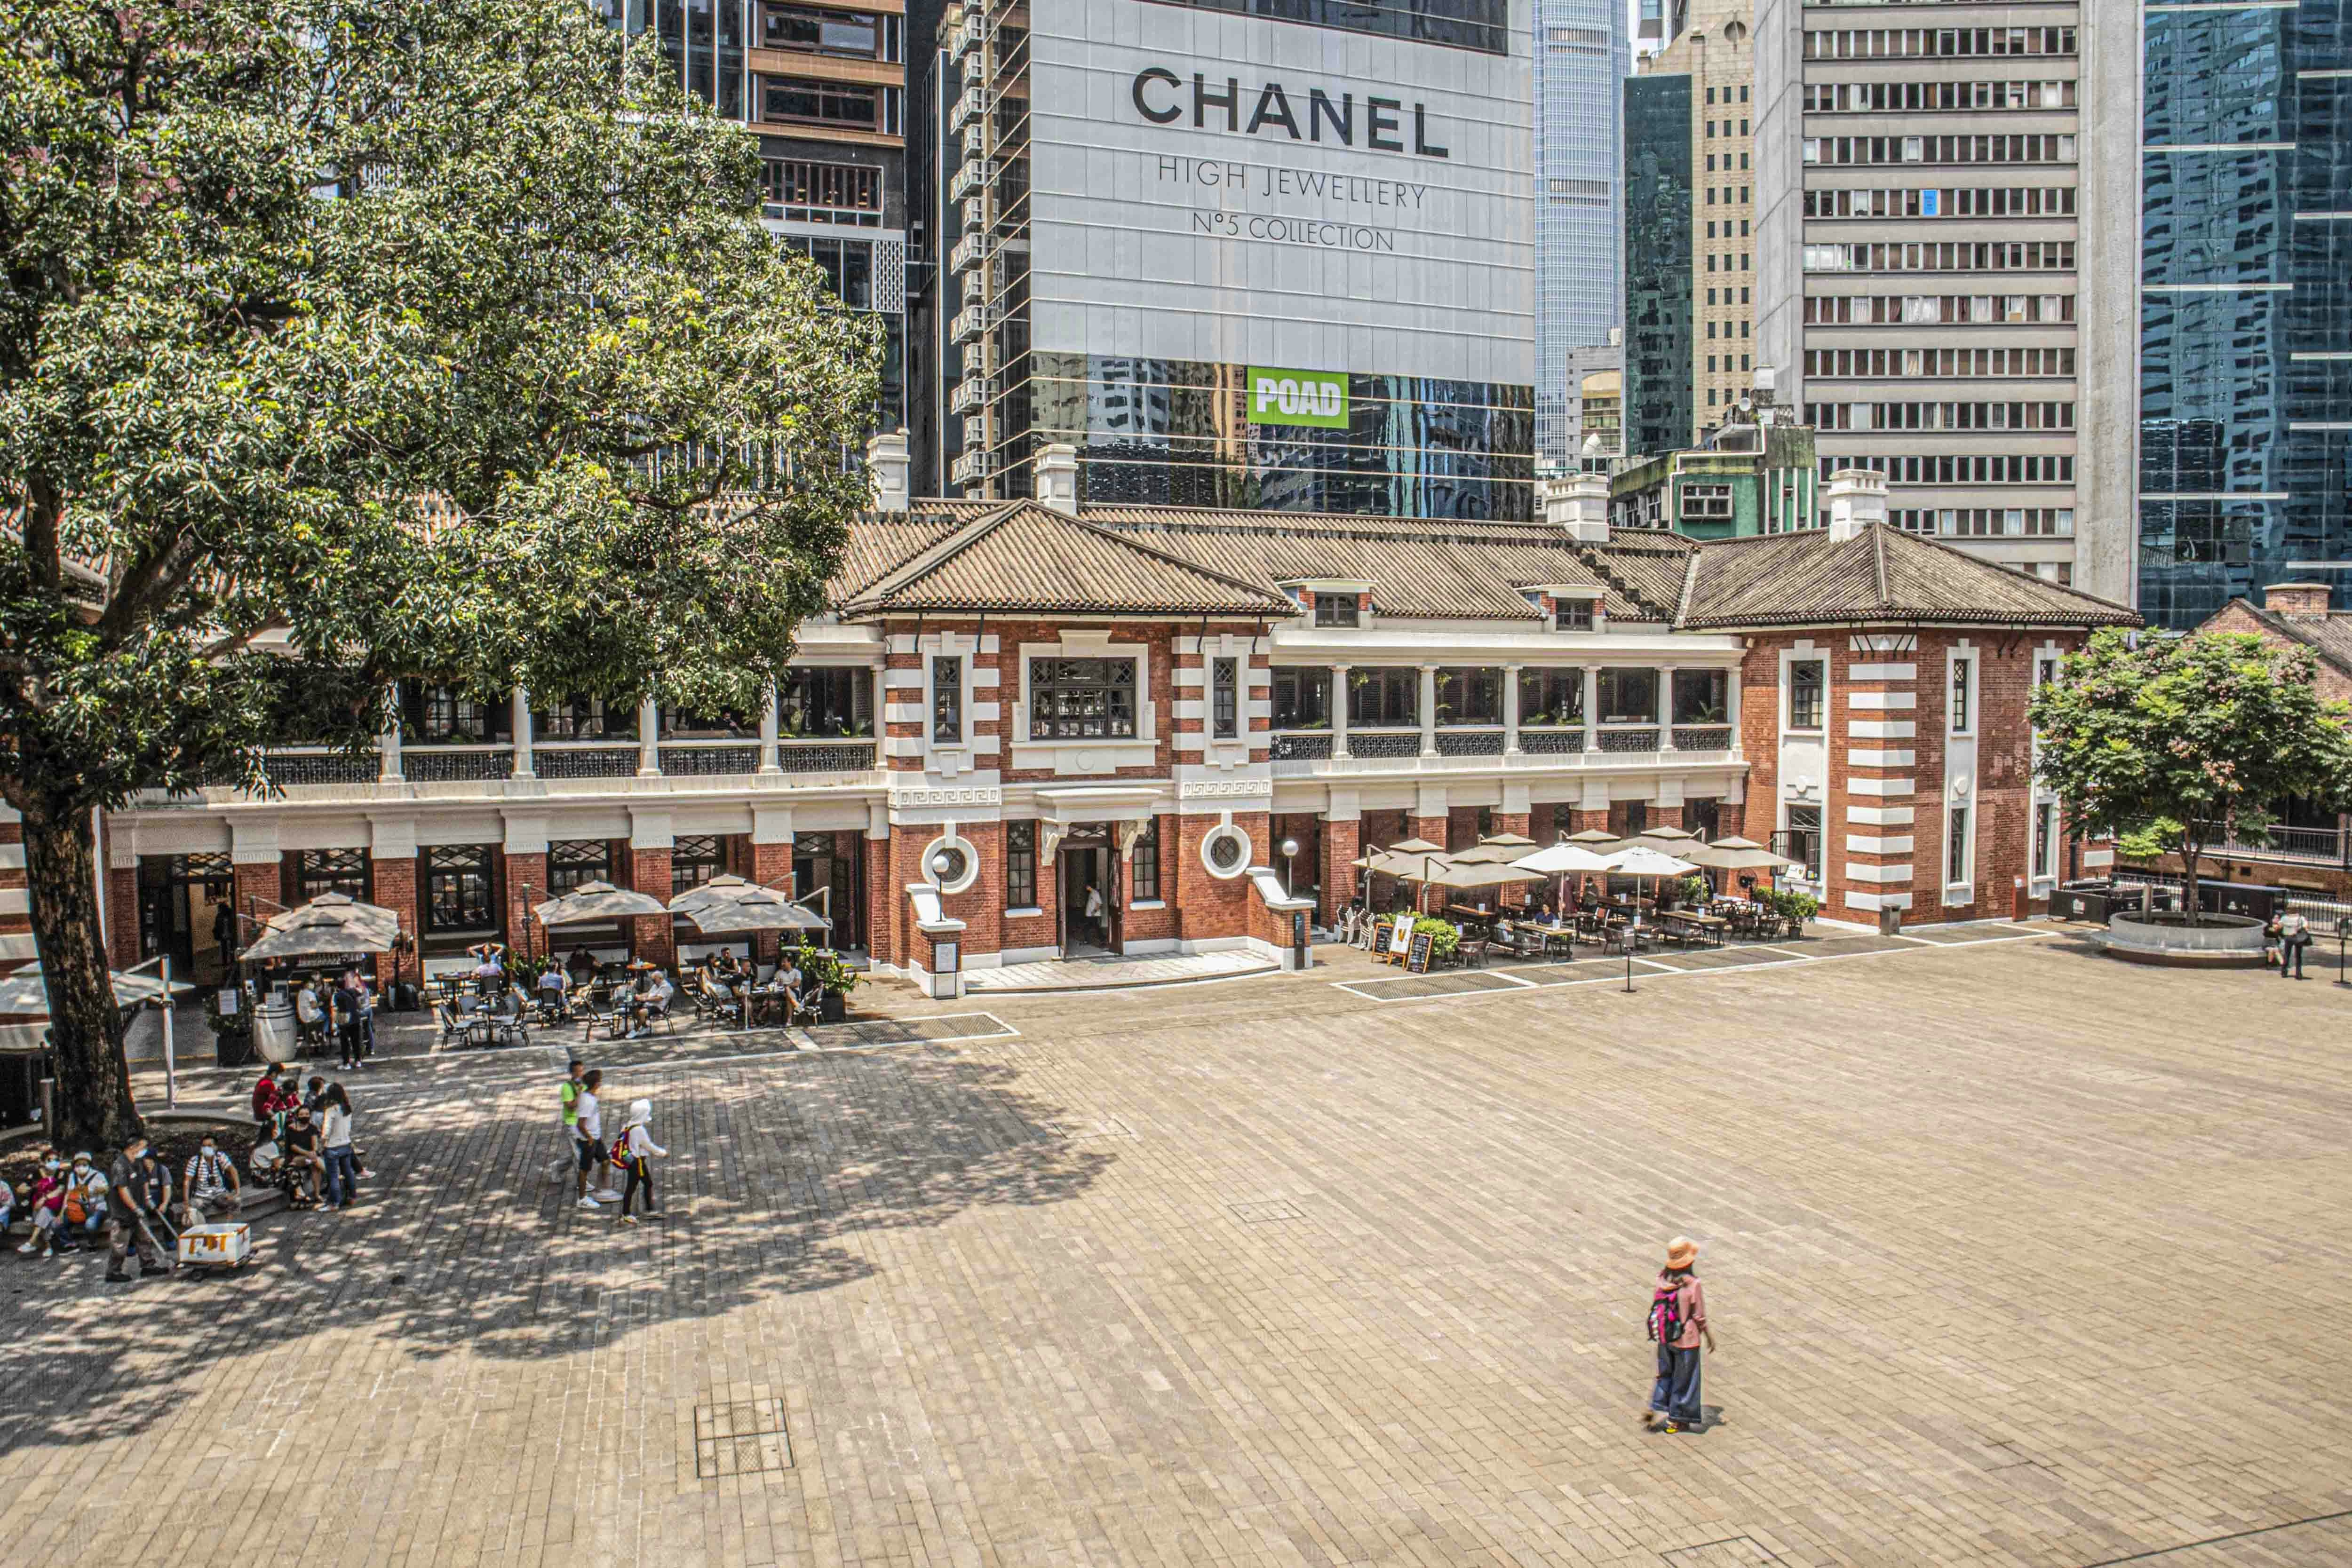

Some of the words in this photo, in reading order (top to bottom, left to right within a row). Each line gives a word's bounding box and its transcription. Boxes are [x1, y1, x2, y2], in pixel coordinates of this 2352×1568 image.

[1132, 67, 1449, 158] CHANEL
[1159, 156, 1245, 189] HIGH
[1262, 167, 1426, 208] JEWELLERY
[1249, 217, 1393, 251] COLLECTION
[1256, 378, 1341, 417] POAD
